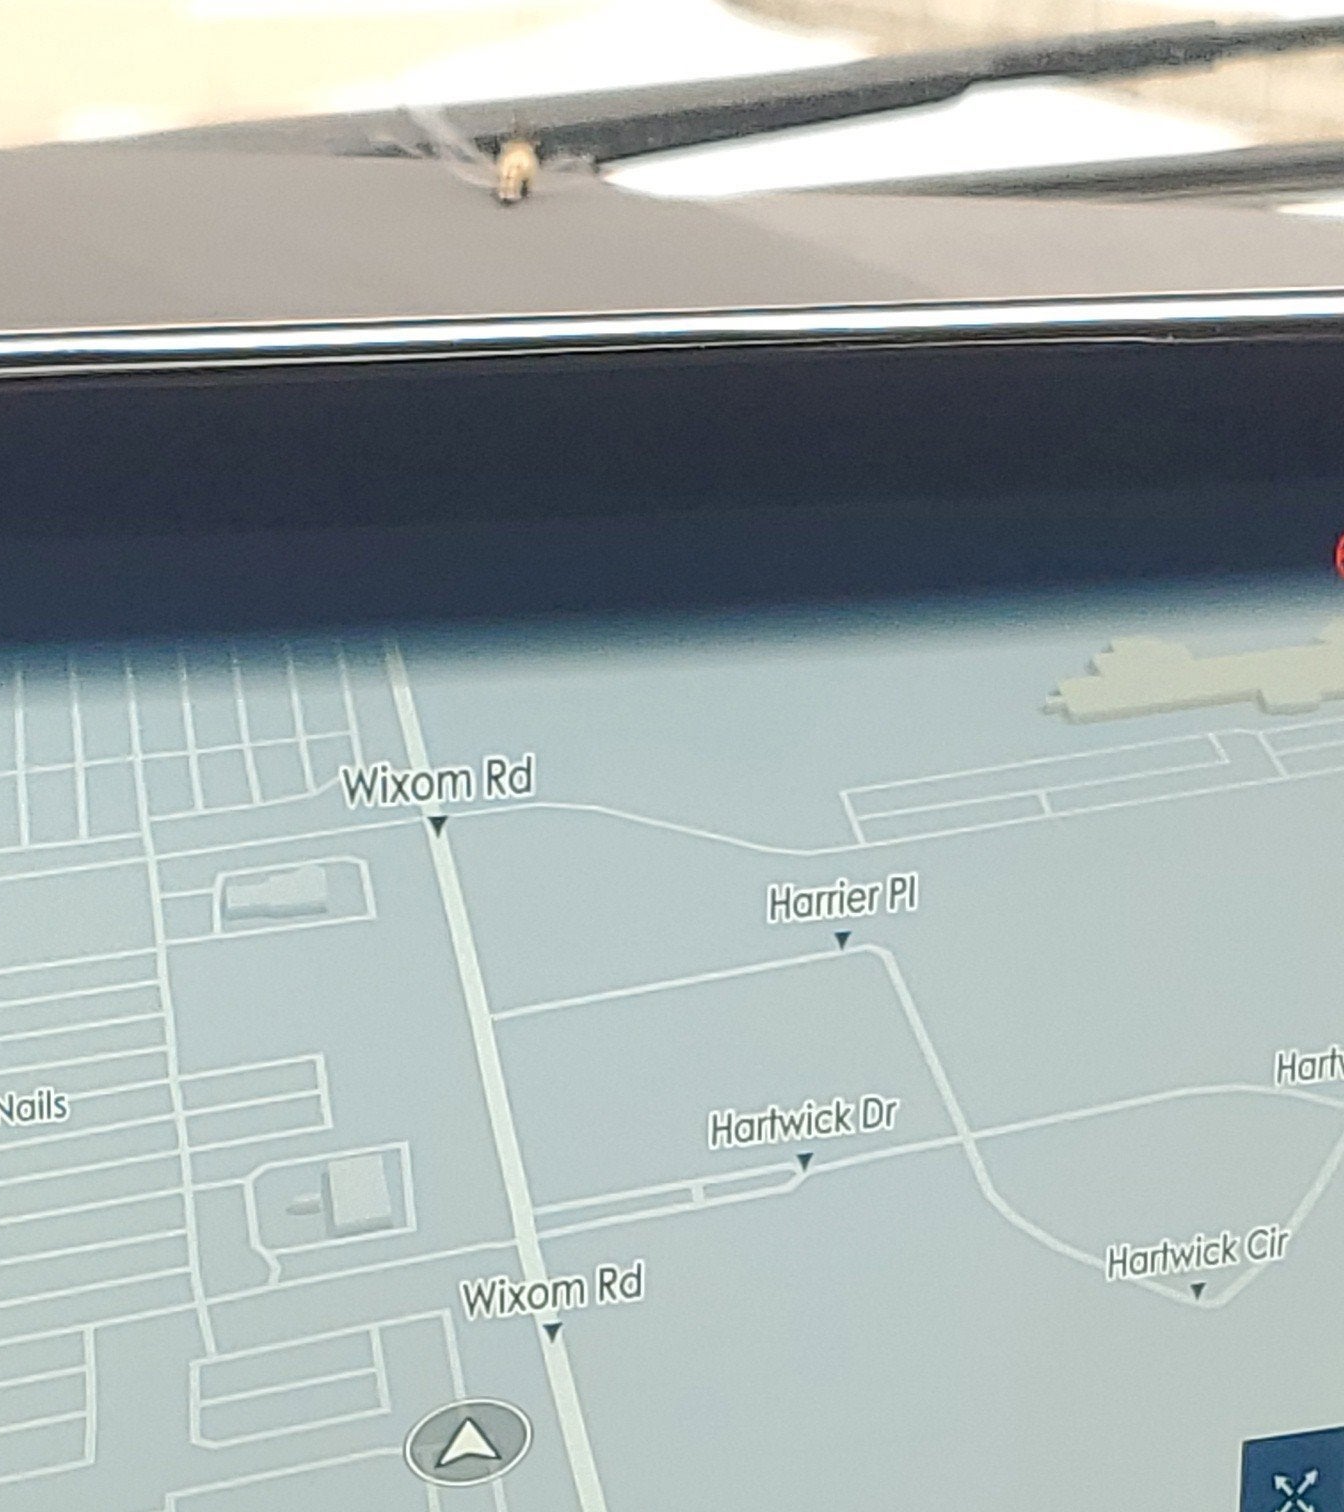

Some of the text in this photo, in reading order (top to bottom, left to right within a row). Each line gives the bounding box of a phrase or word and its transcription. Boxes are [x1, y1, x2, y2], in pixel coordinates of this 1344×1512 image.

[342, 755, 535, 806] Wixom Rd
[768, 874, 918, 924] Harrier Pl
[709, 1097, 898, 1149] Hartwick Dr
[1107, 1226, 1288, 1278] Hartwick Cir
[462, 1265, 644, 1317] Wixom Rd
